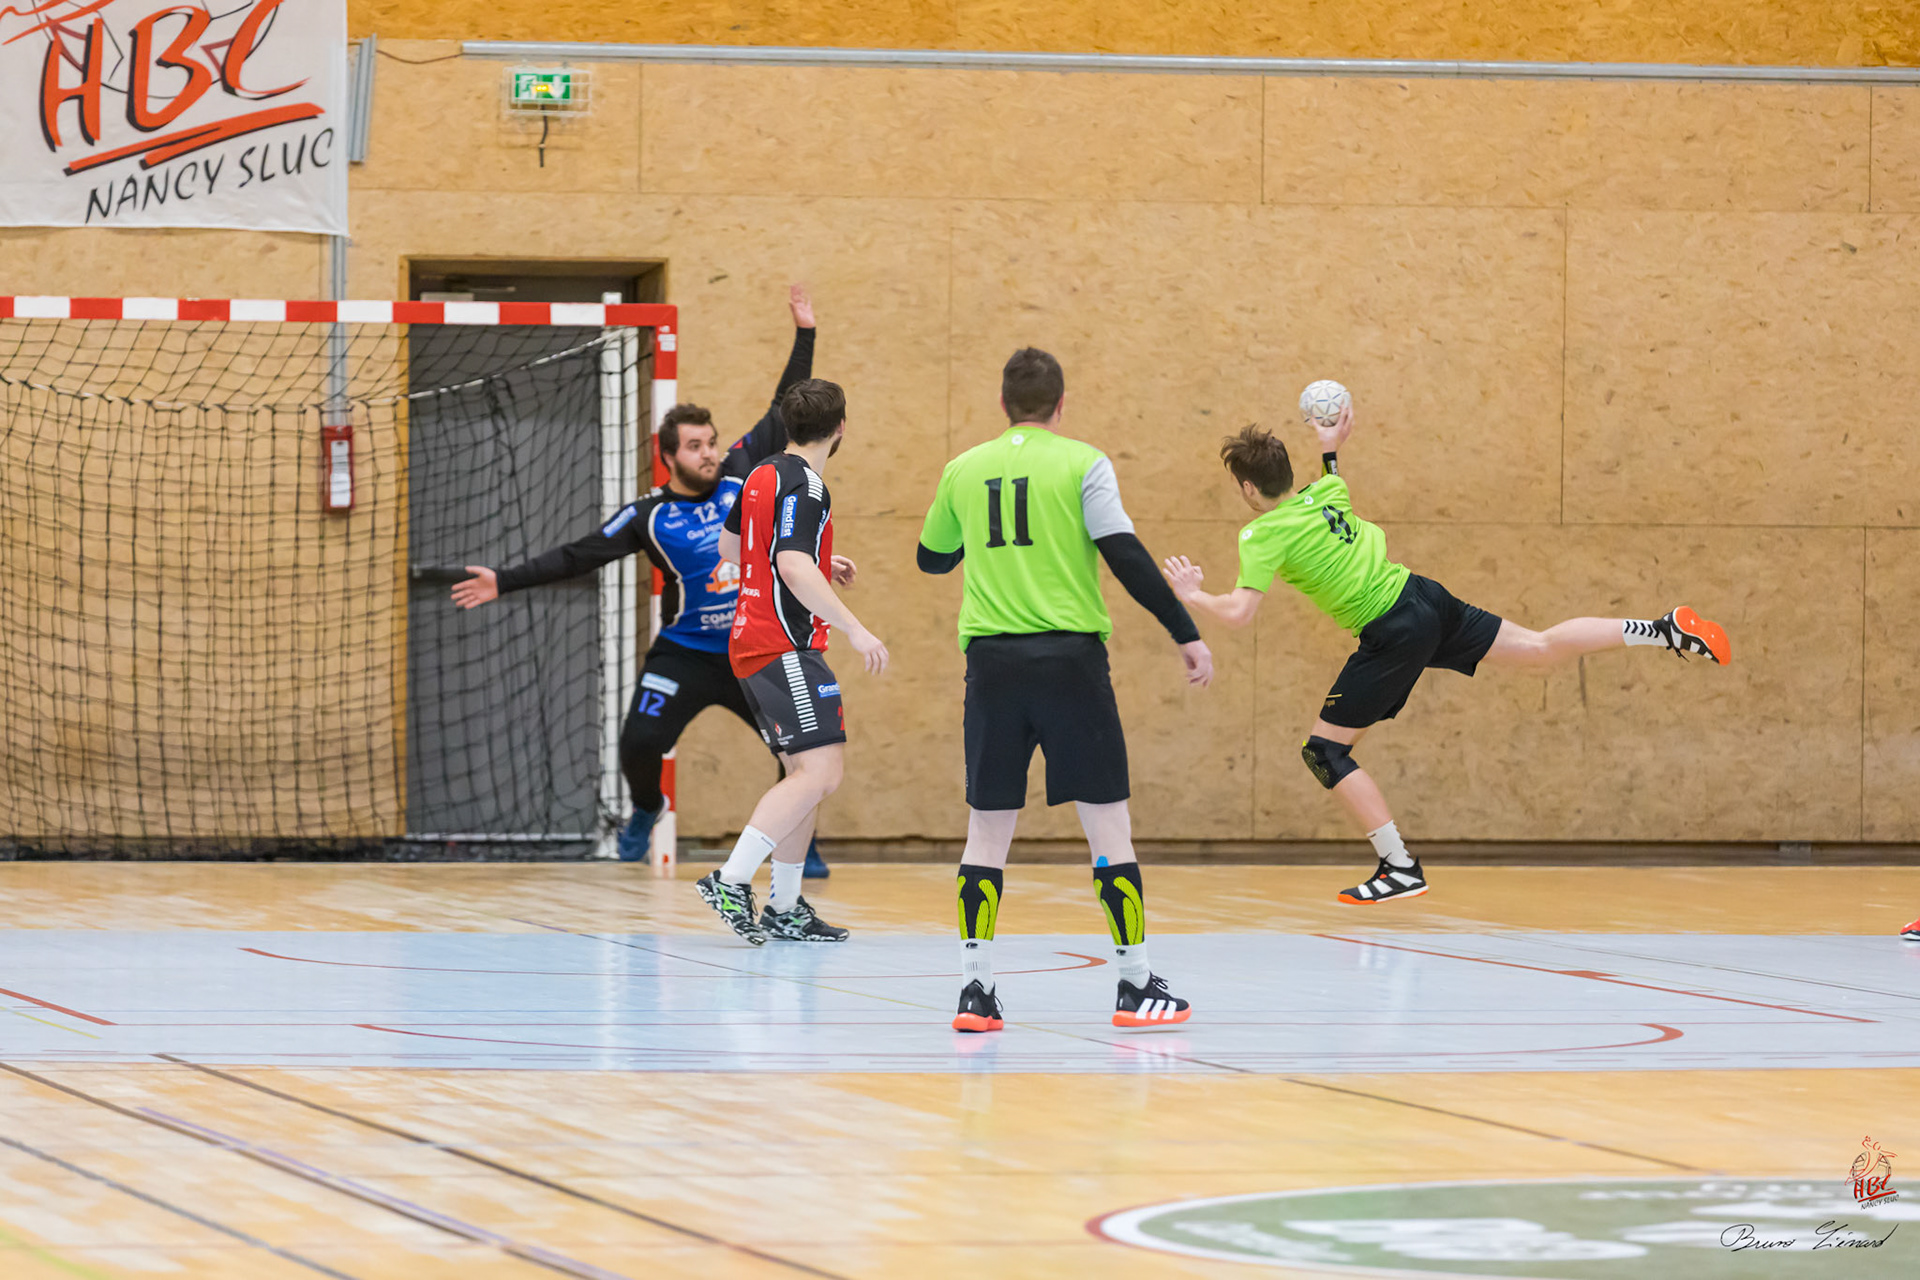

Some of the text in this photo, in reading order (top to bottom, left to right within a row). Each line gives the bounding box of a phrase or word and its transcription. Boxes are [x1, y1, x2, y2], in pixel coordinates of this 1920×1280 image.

[39, 0, 311, 152] HBC
[85, 128, 334, 224] NANCY SLUC
[693, 502, 720, 524] 12
[984, 475, 1034, 549] 11
[638, 690, 666, 717] 12
